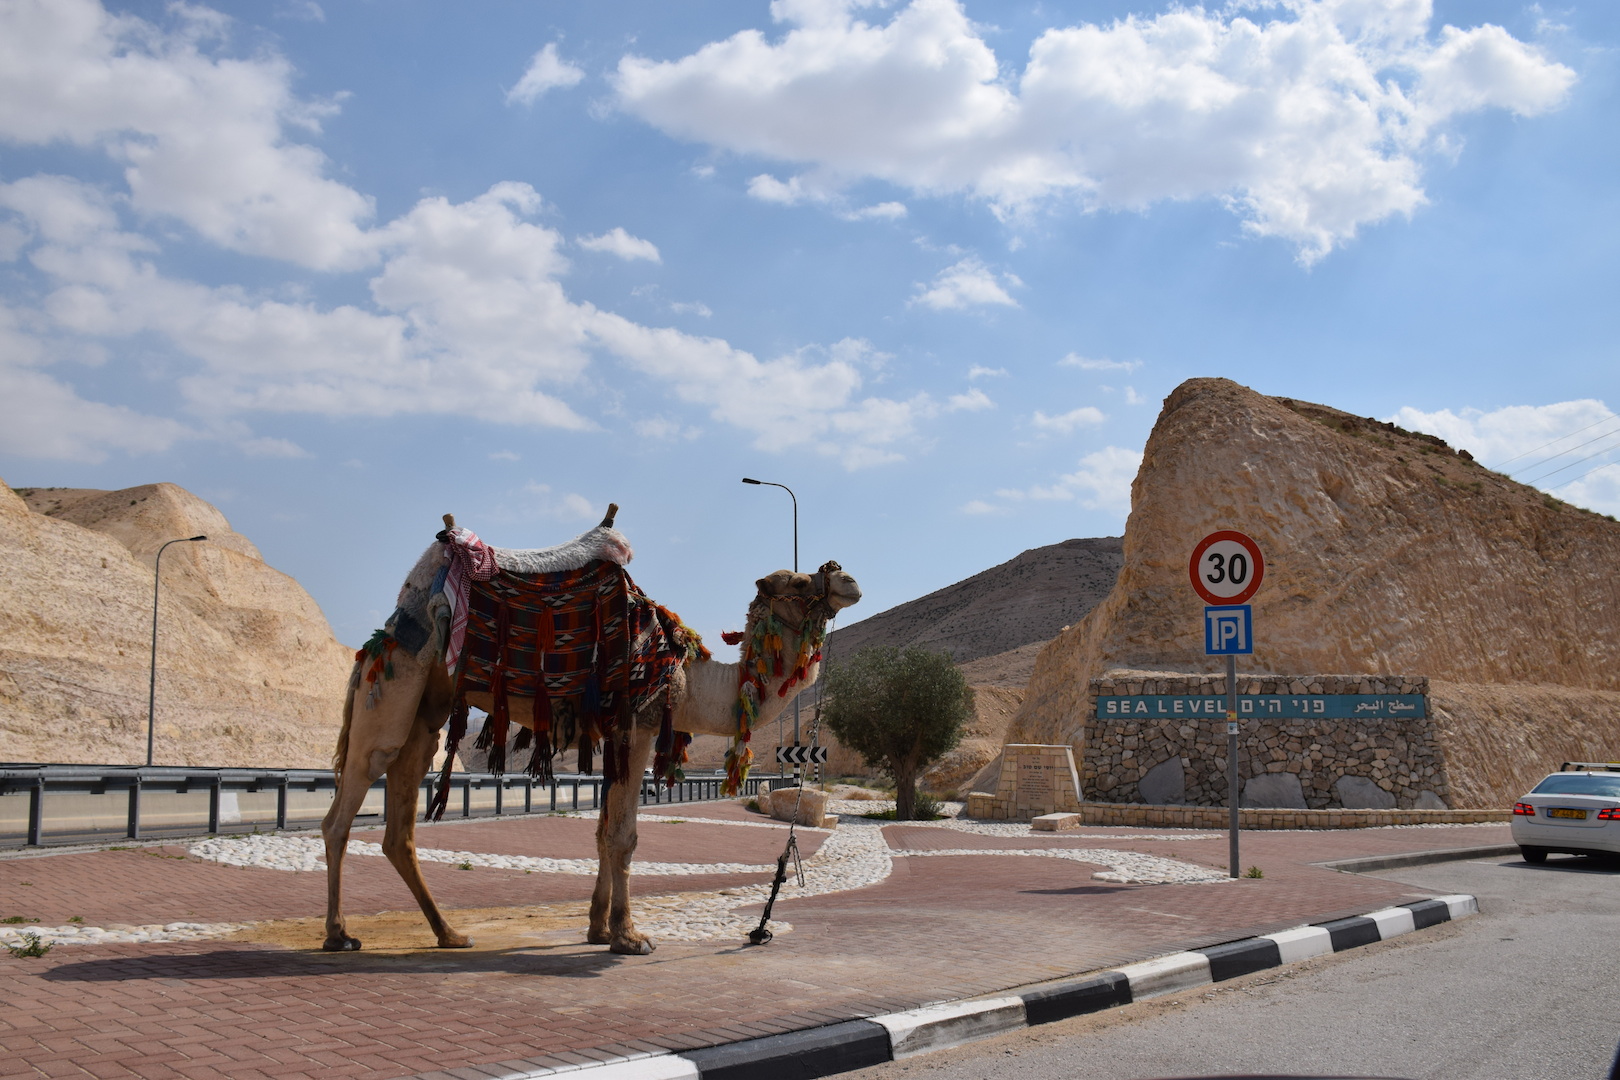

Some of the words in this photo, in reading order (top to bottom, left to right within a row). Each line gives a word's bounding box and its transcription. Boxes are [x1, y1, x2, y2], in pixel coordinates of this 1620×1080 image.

[1206, 553, 1247, 584] 30
[1107, 701, 1148, 713] SEA
[1158, 700, 1227, 713] LEVEL
[1241, 699, 1281, 713] הים
[1291, 699, 1325, 713] פני
[1354, 700, 1384, 715] البحر
[1388, 700, 1415, 713] سطح
